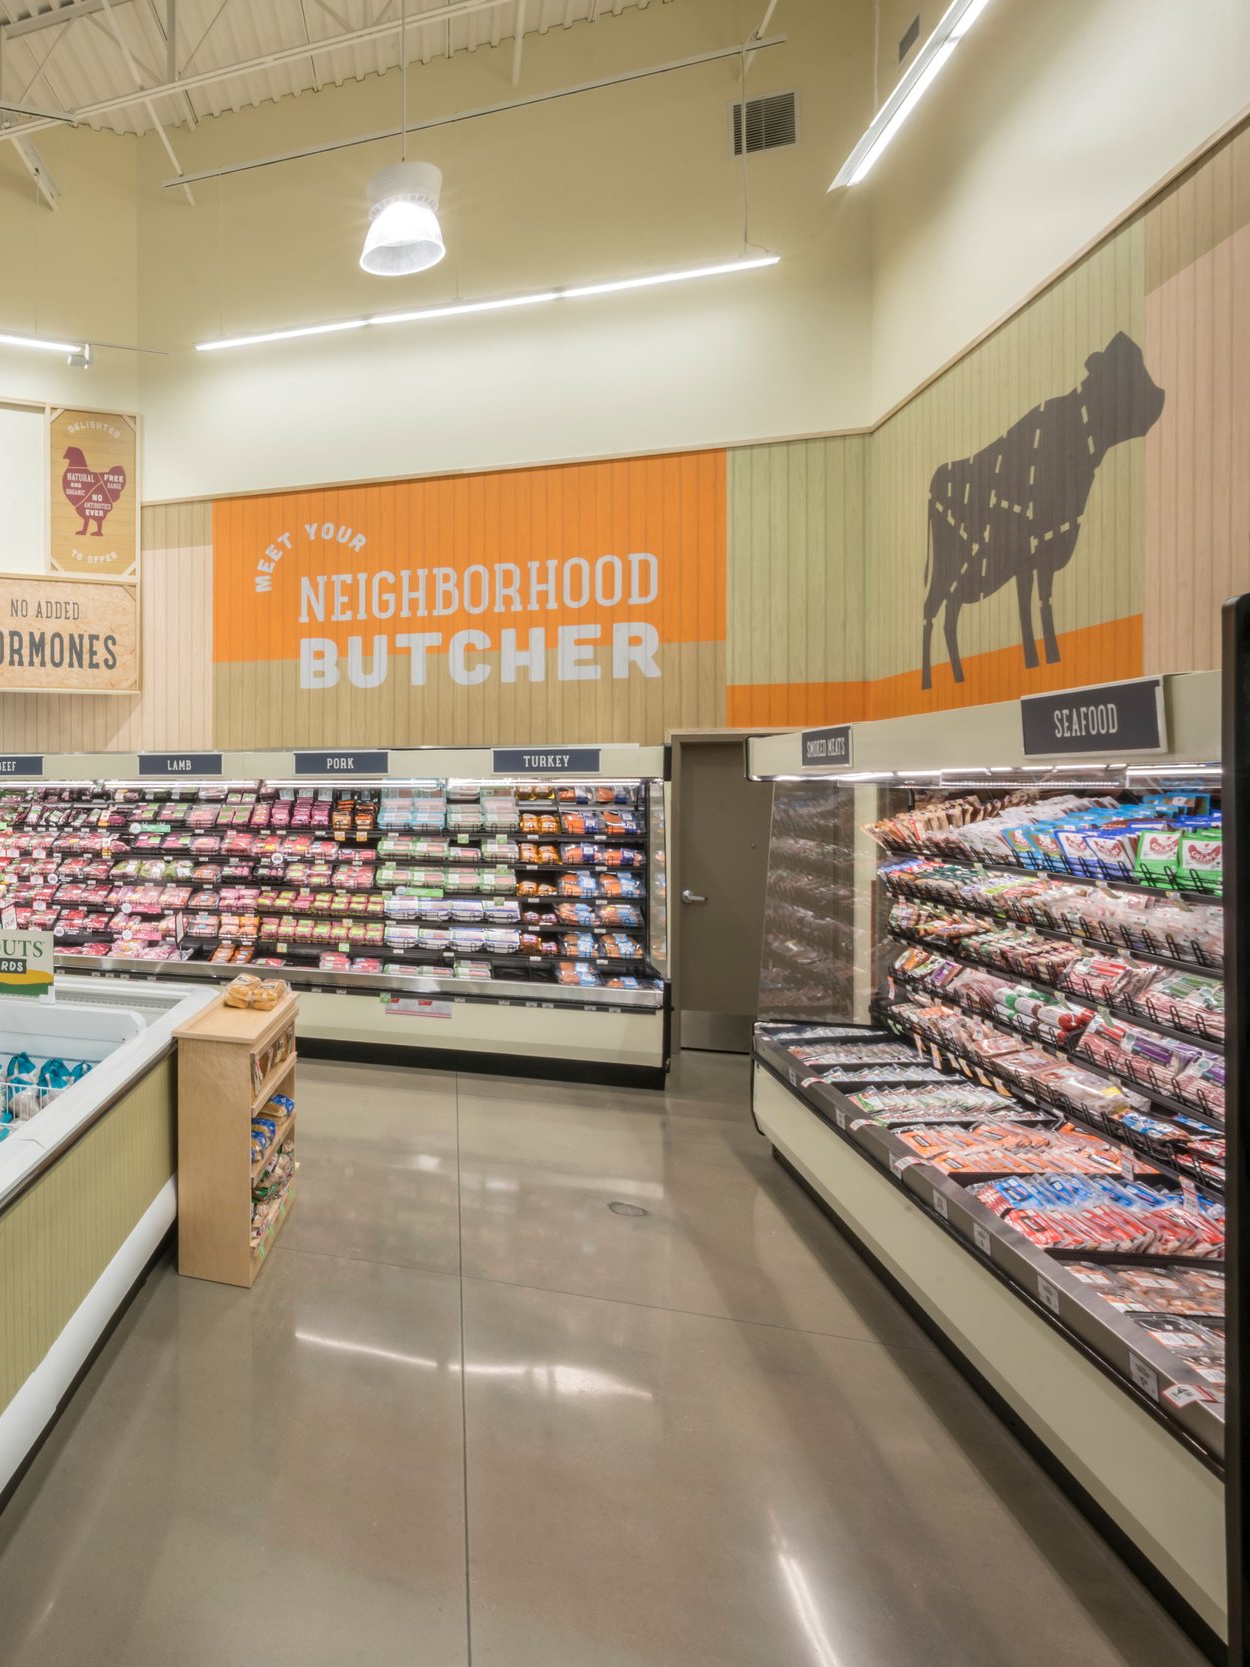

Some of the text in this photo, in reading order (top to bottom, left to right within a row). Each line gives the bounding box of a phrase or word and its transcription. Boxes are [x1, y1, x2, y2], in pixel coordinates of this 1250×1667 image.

[67, 420, 121, 439] DELIGHTED
[66, 472, 95, 483] NATURAL
[104, 474, 124, 483] FREE
[91, 494, 103, 502] NO
[84, 502, 111, 510] ANTIBIOTICS
[85, 509, 104, 517] EVER
[71, 549, 118, 564] TO OFFER
[255, 522, 367, 594] MEET YOUR
[298, 552, 659, 623] NEIGHBORHOOD
[10, 598, 80, 621] NO ADDED
[299, 621, 663, 690] BUTCHER
[1053, 703, 1118, 738] SEAFOOD
[806, 737, 845, 758] SMOKED MEATS
[167, 758, 192, 771] LAMB
[326, 757, 355, 770] PORK
[522, 755, 570, 768] TURKEY
